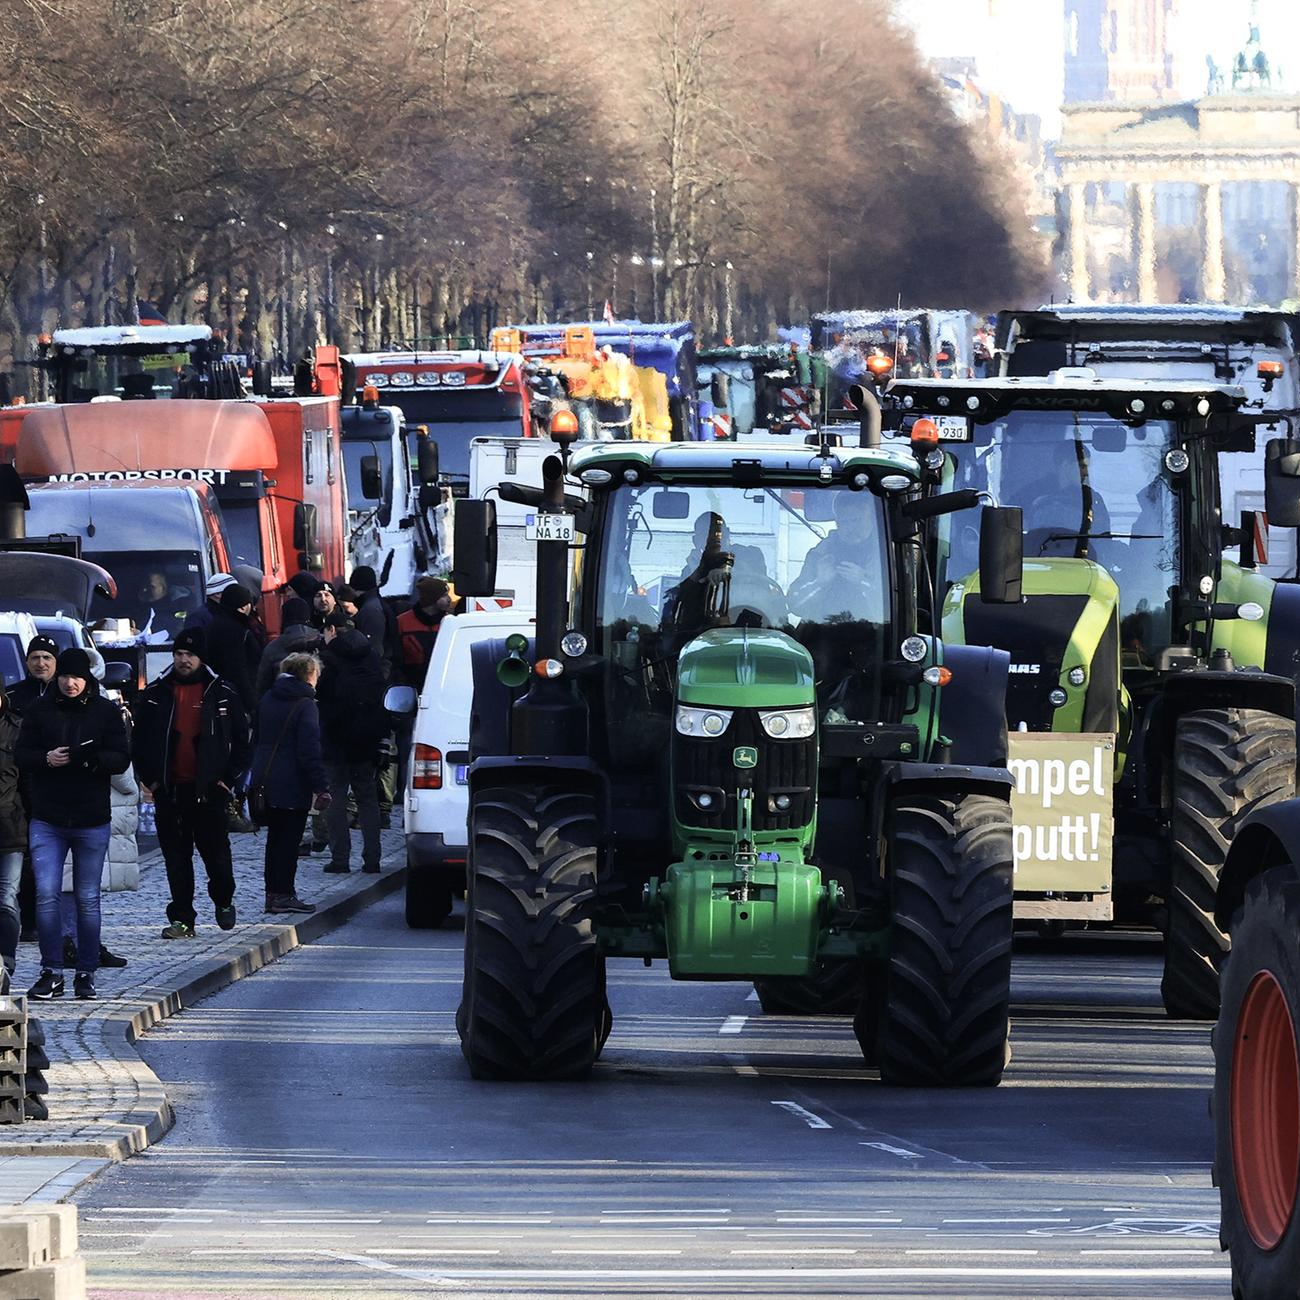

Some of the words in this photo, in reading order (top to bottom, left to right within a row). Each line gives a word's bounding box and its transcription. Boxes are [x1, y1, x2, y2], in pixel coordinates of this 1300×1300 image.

[933, 417, 946, 427] TF
[536, 516, 551, 526] TF
[536, 528, 551, 538] NA
[556, 528, 570, 538] 18
